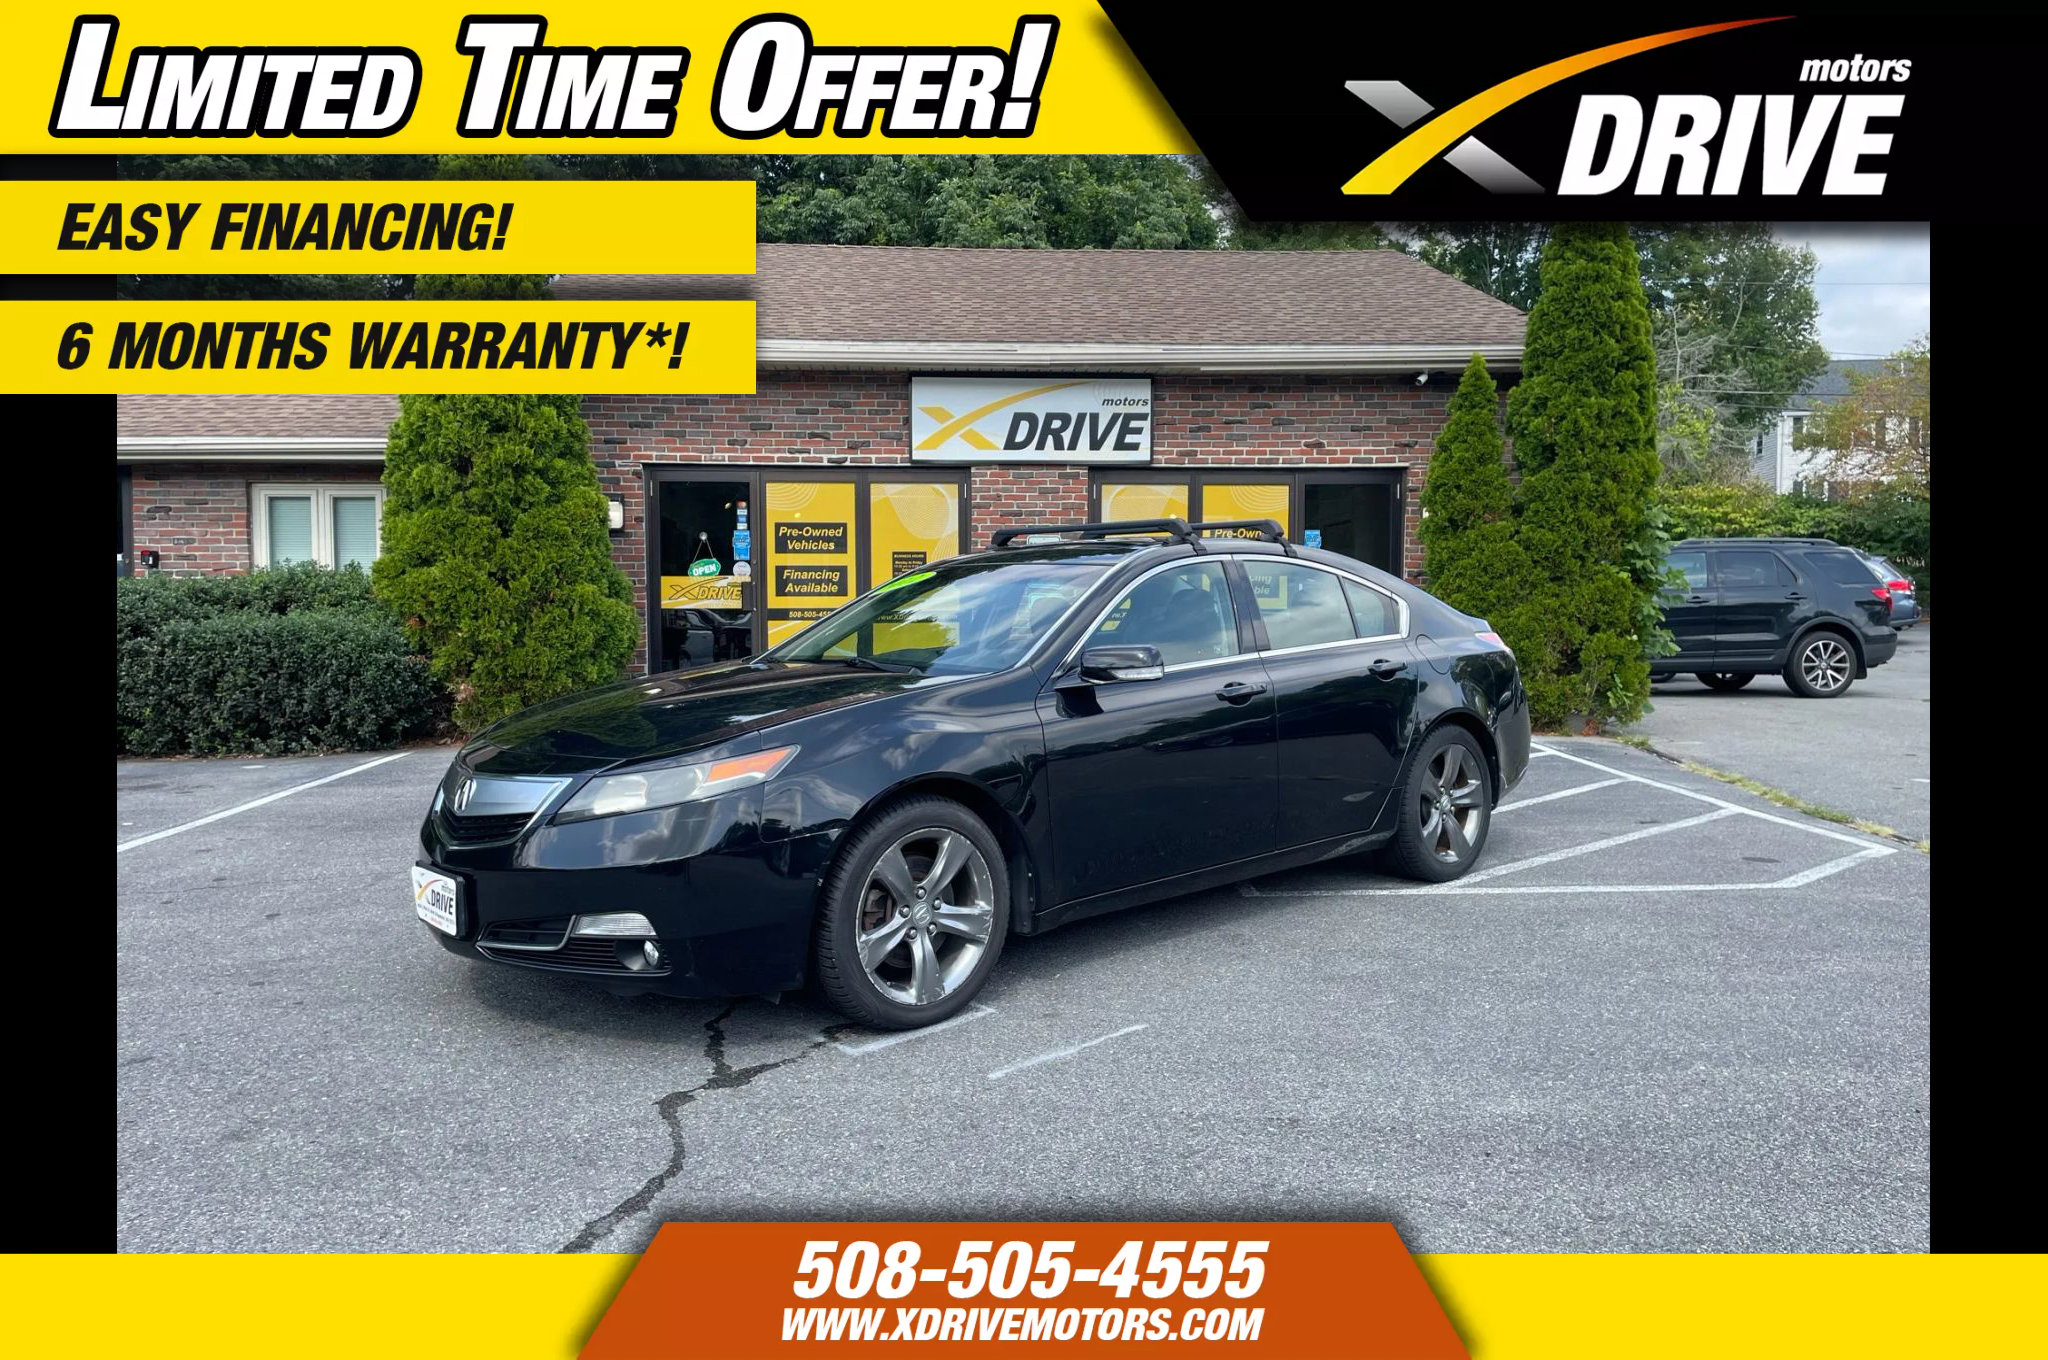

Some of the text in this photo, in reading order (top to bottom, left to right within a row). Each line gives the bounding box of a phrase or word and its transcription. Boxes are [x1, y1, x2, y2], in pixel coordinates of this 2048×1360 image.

[1101, 396, 1150, 407] motors
[778, 526, 844, 537] Pre-Owned
[1214, 528, 1264, 538] Pre-Own
[787, 539, 836, 550] Vehicles
[692, 563, 717, 577] OPEN
[783, 570, 841, 581] Financing
[785, 583, 839, 593] Available
[789, 610, 832, 618] 508-505-455
